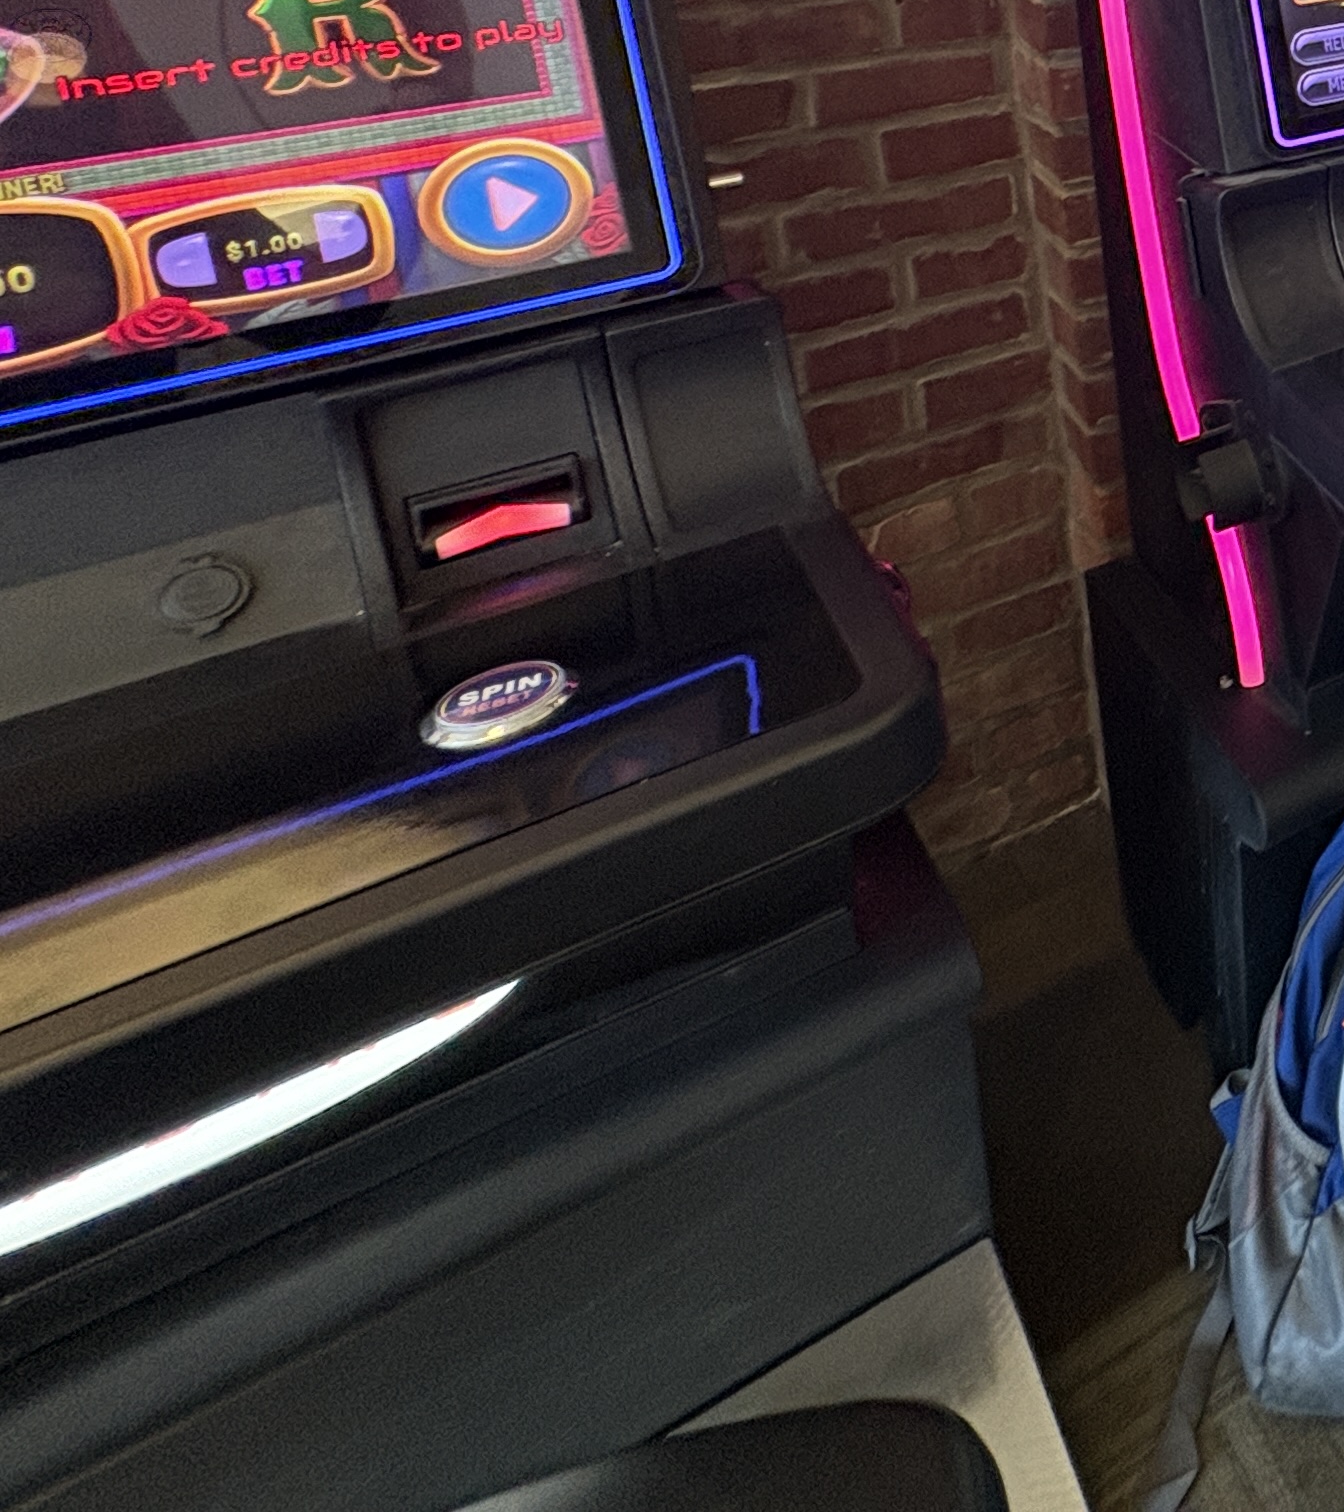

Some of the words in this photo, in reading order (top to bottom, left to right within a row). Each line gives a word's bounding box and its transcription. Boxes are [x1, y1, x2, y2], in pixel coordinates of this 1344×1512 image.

[55, 57, 215, 102] Insert
[230, 34, 402, 78] credits
[413, 30, 464, 55] to
[473, 16, 565, 53] play
[225, 231, 302, 263] $1.00
[242, 260, 305, 291] BET
[457, 672, 543, 707] SPIN
